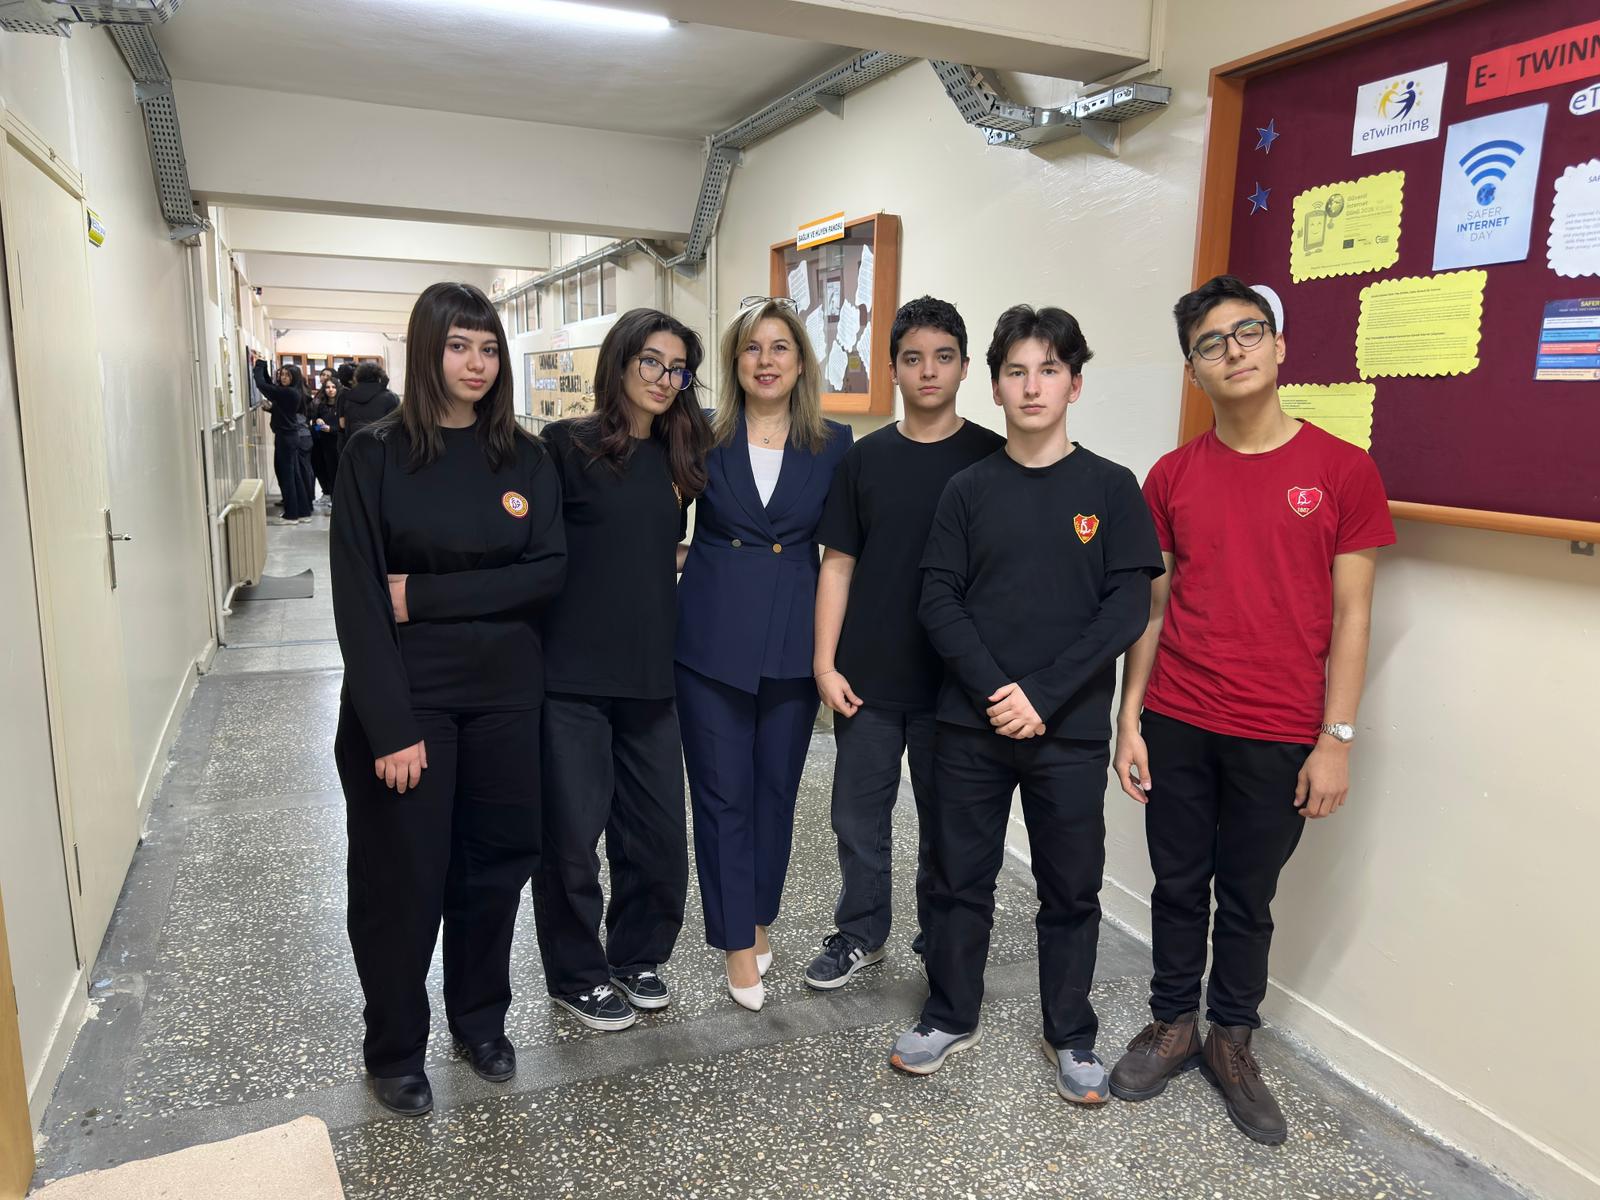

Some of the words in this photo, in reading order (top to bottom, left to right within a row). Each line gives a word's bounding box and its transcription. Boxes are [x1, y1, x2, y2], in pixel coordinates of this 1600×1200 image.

[1475, 65, 1496, 88] E-
[1362, 118, 1429, 141] eTwinning
[1467, 206, 1502, 220] SAFER
[1457, 216, 1510, 232] INTERNET
[1470, 230, 1493, 242] DAY
